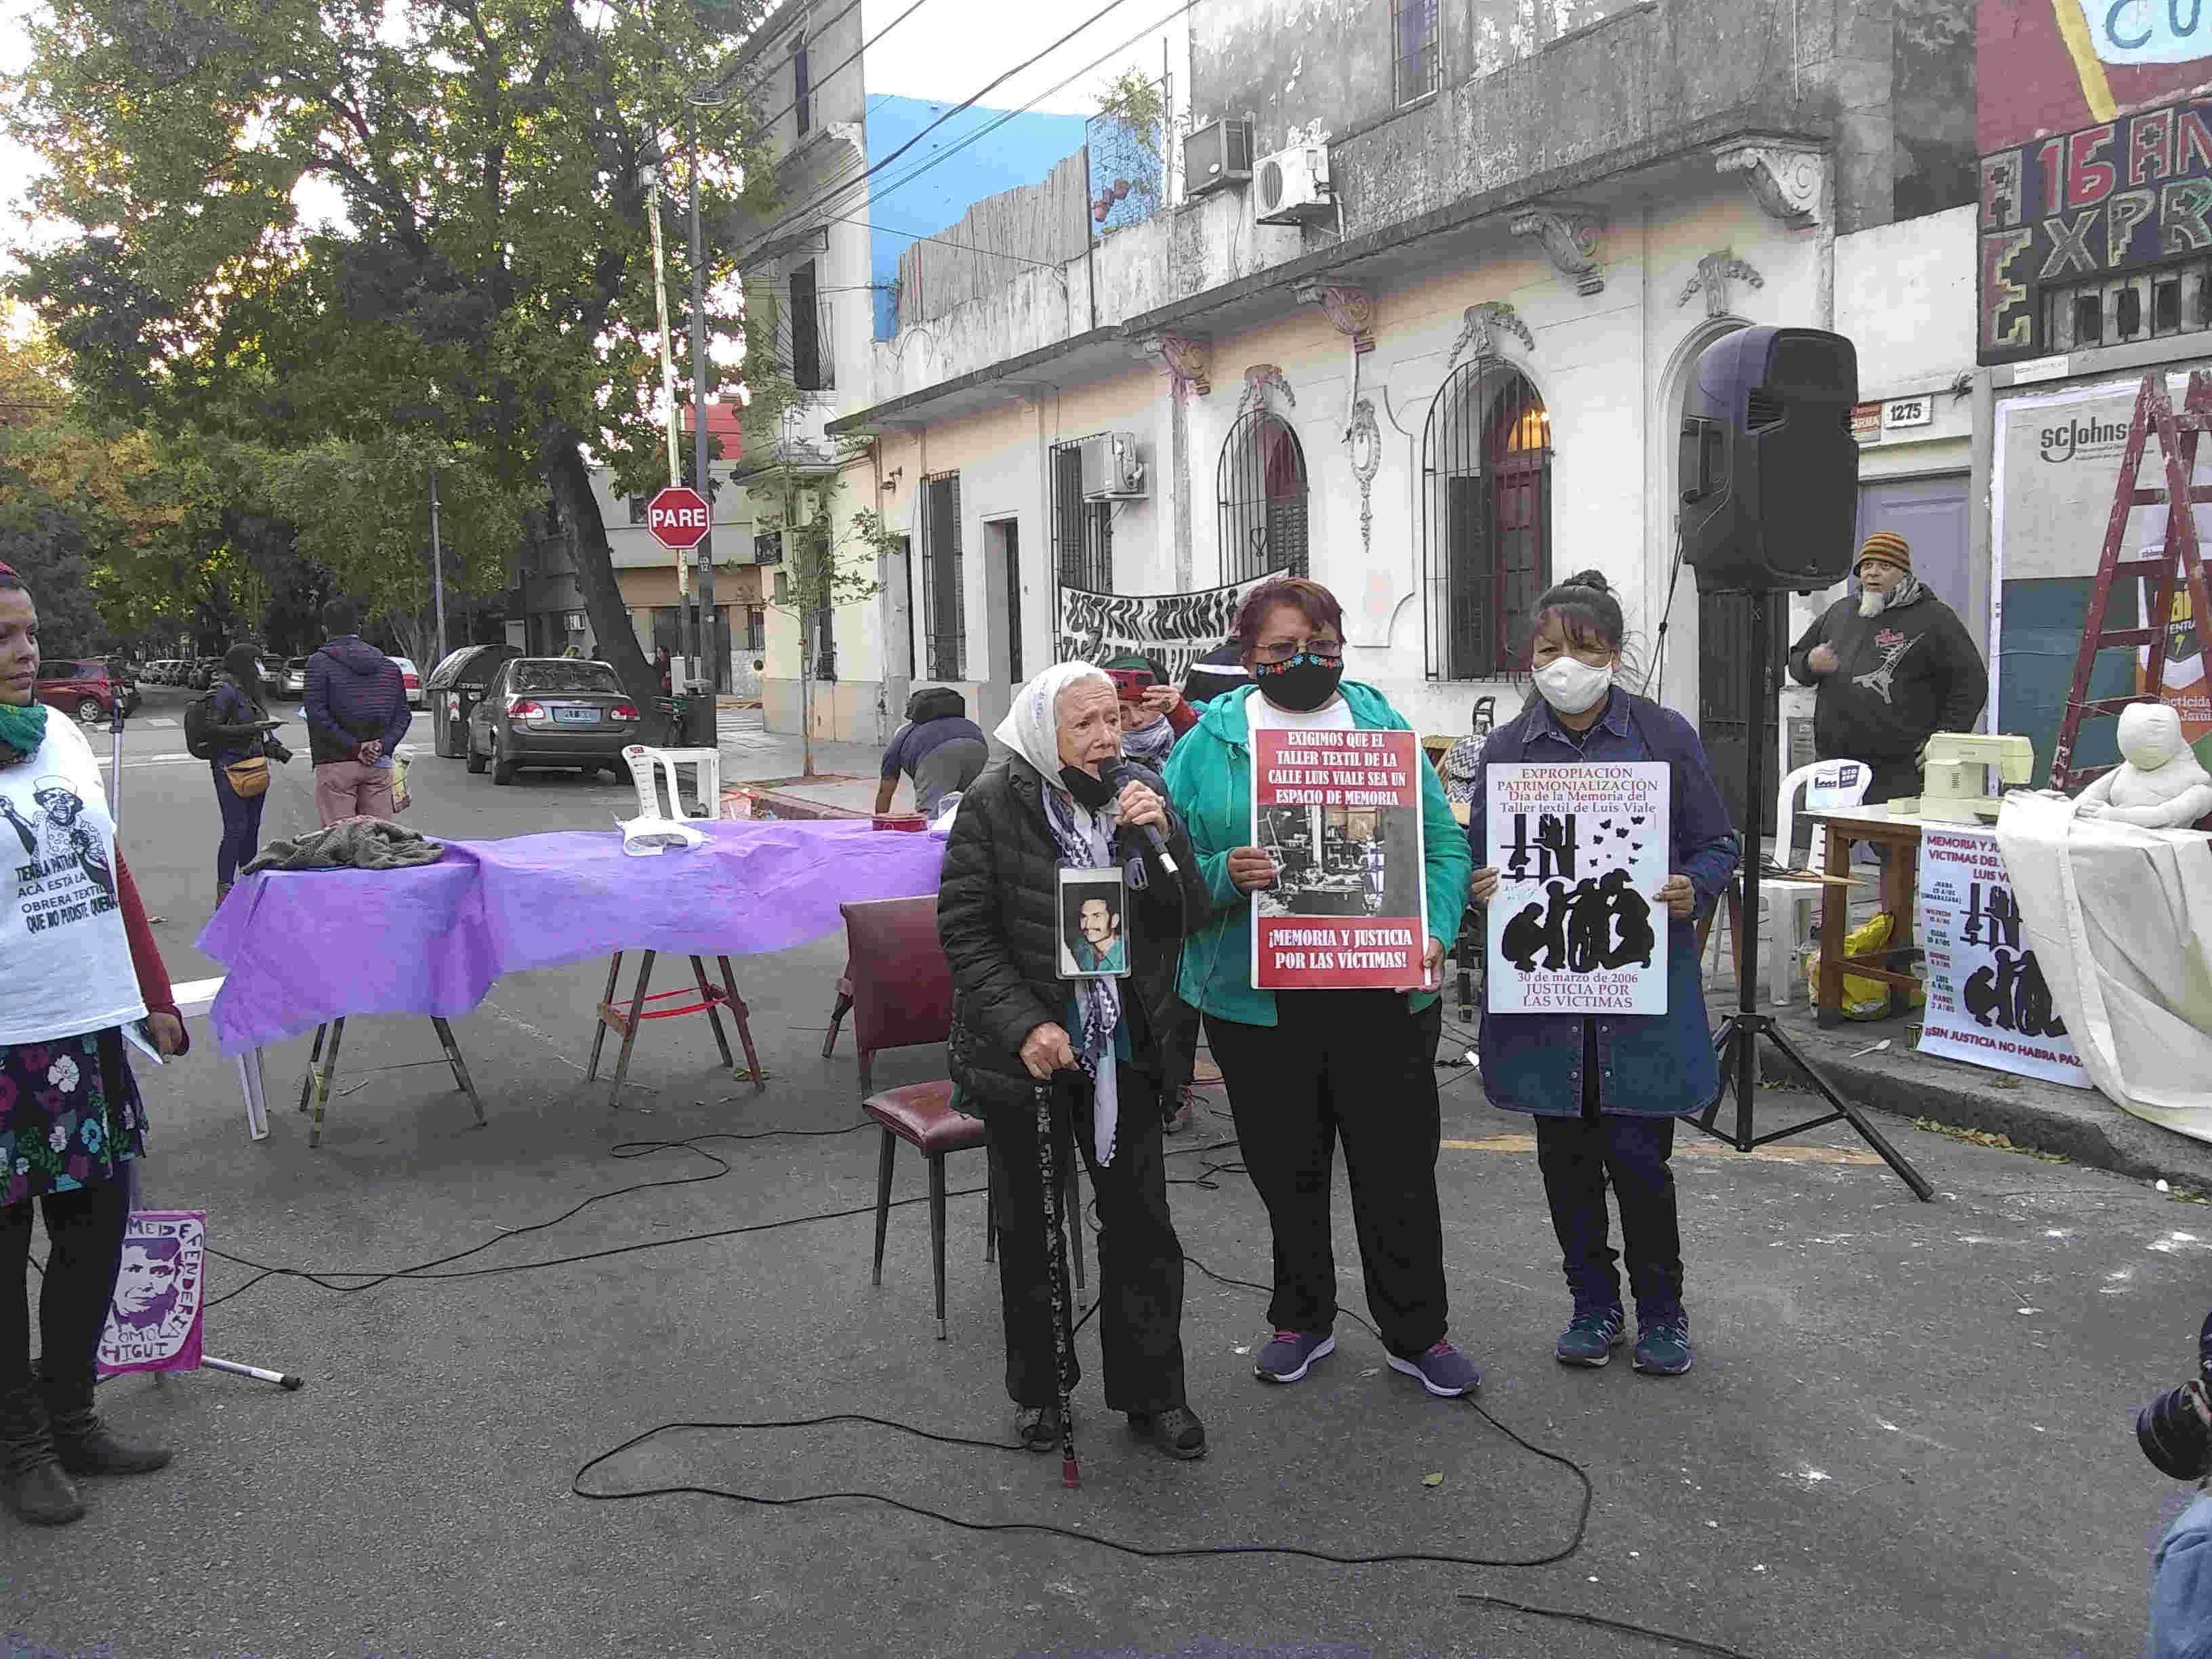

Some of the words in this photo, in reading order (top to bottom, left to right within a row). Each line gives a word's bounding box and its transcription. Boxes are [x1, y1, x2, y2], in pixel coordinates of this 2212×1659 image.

[2036, 123, 2115, 216] 15
[1890, 403, 1923, 422] 1275
[651, 508, 707, 527] PARE
[1287, 731, 1345, 747] EXIGIMOS
[1346, 733, 1369, 748] QUE
[1371, 733, 1385, 747] EL
[1275, 750, 1319, 765] TALLER
[1322, 751, 1361, 766] TEXTIL
[1364, 752, 1380, 766] DE
[1382, 752, 1398, 767] LA
[1268, 769, 1302, 785] CALLE
[1305, 770, 1330, 785] LUIS
[1332, 771, 1366, 786] VIALE
[1368, 771, 1389, 786] SEA
[1391, 772, 1406, 787] UN
[1521, 765, 1633, 779] EXPROPIACIÓN
[1496, 778, 1660, 792] PATRIMONIALIZACIÓN
[1275, 789, 1324, 804] ESPACIO
[1326, 790, 1343, 804] DE
[1345, 790, 1399, 805] MEMORIA
[1534, 791, 1550, 801] de
[1553, 791, 1564, 801] la
[1566, 792, 1624, 801] Memoria
[1626, 792, 1647, 801] del
[1500, 802, 1536, 813] Taller
[1538, 802, 1570, 813] textil
[1573, 802, 1589, 813] de
[1592, 802, 1620, 813] Luis
[1622, 802, 1656, 813] Viale
[1926, 834, 1978, 850] MEMORIA
[1978, 840, 1987, 852] Y
[1929, 849, 1978, 864] VICTIMAS
[1980, 855, 2000, 867] DEL
[75, 872, 87, 884] LA
[1973, 868, 1996, 880] LUIS
[21, 895, 73, 914] OBRERA
[26, 914, 46, 934] QUE
[1268, 928, 1337, 949] ¡MEMORIA
[1339, 929, 1351, 946] Y
[1353, 928, 1414, 948] JUSTICIA
[1274, 952, 1307, 970] POR
[1309, 951, 1335, 969] LAS
[1336, 949, 1408, 970] VÍCTIMAS!
[1517, 972, 1531, 982] 30
[1534, 972, 1549, 982] de
[1552, 974, 1590, 983] marzo
[1593, 972, 1608, 983] de
[1611, 973, 1638, 983] 2006
[1523, 983, 1595, 996] JUSTICIA
[1598, 984, 1630, 996] POR
[1523, 996, 1552, 1007] LAS
[1950, 1030, 1998, 1049] JUSTICIA
[1999, 1041, 2017, 1053] NO
[2018, 1044, 2057, 1063] HABRA
[2058, 1053, 2083, 1067] PAZ
